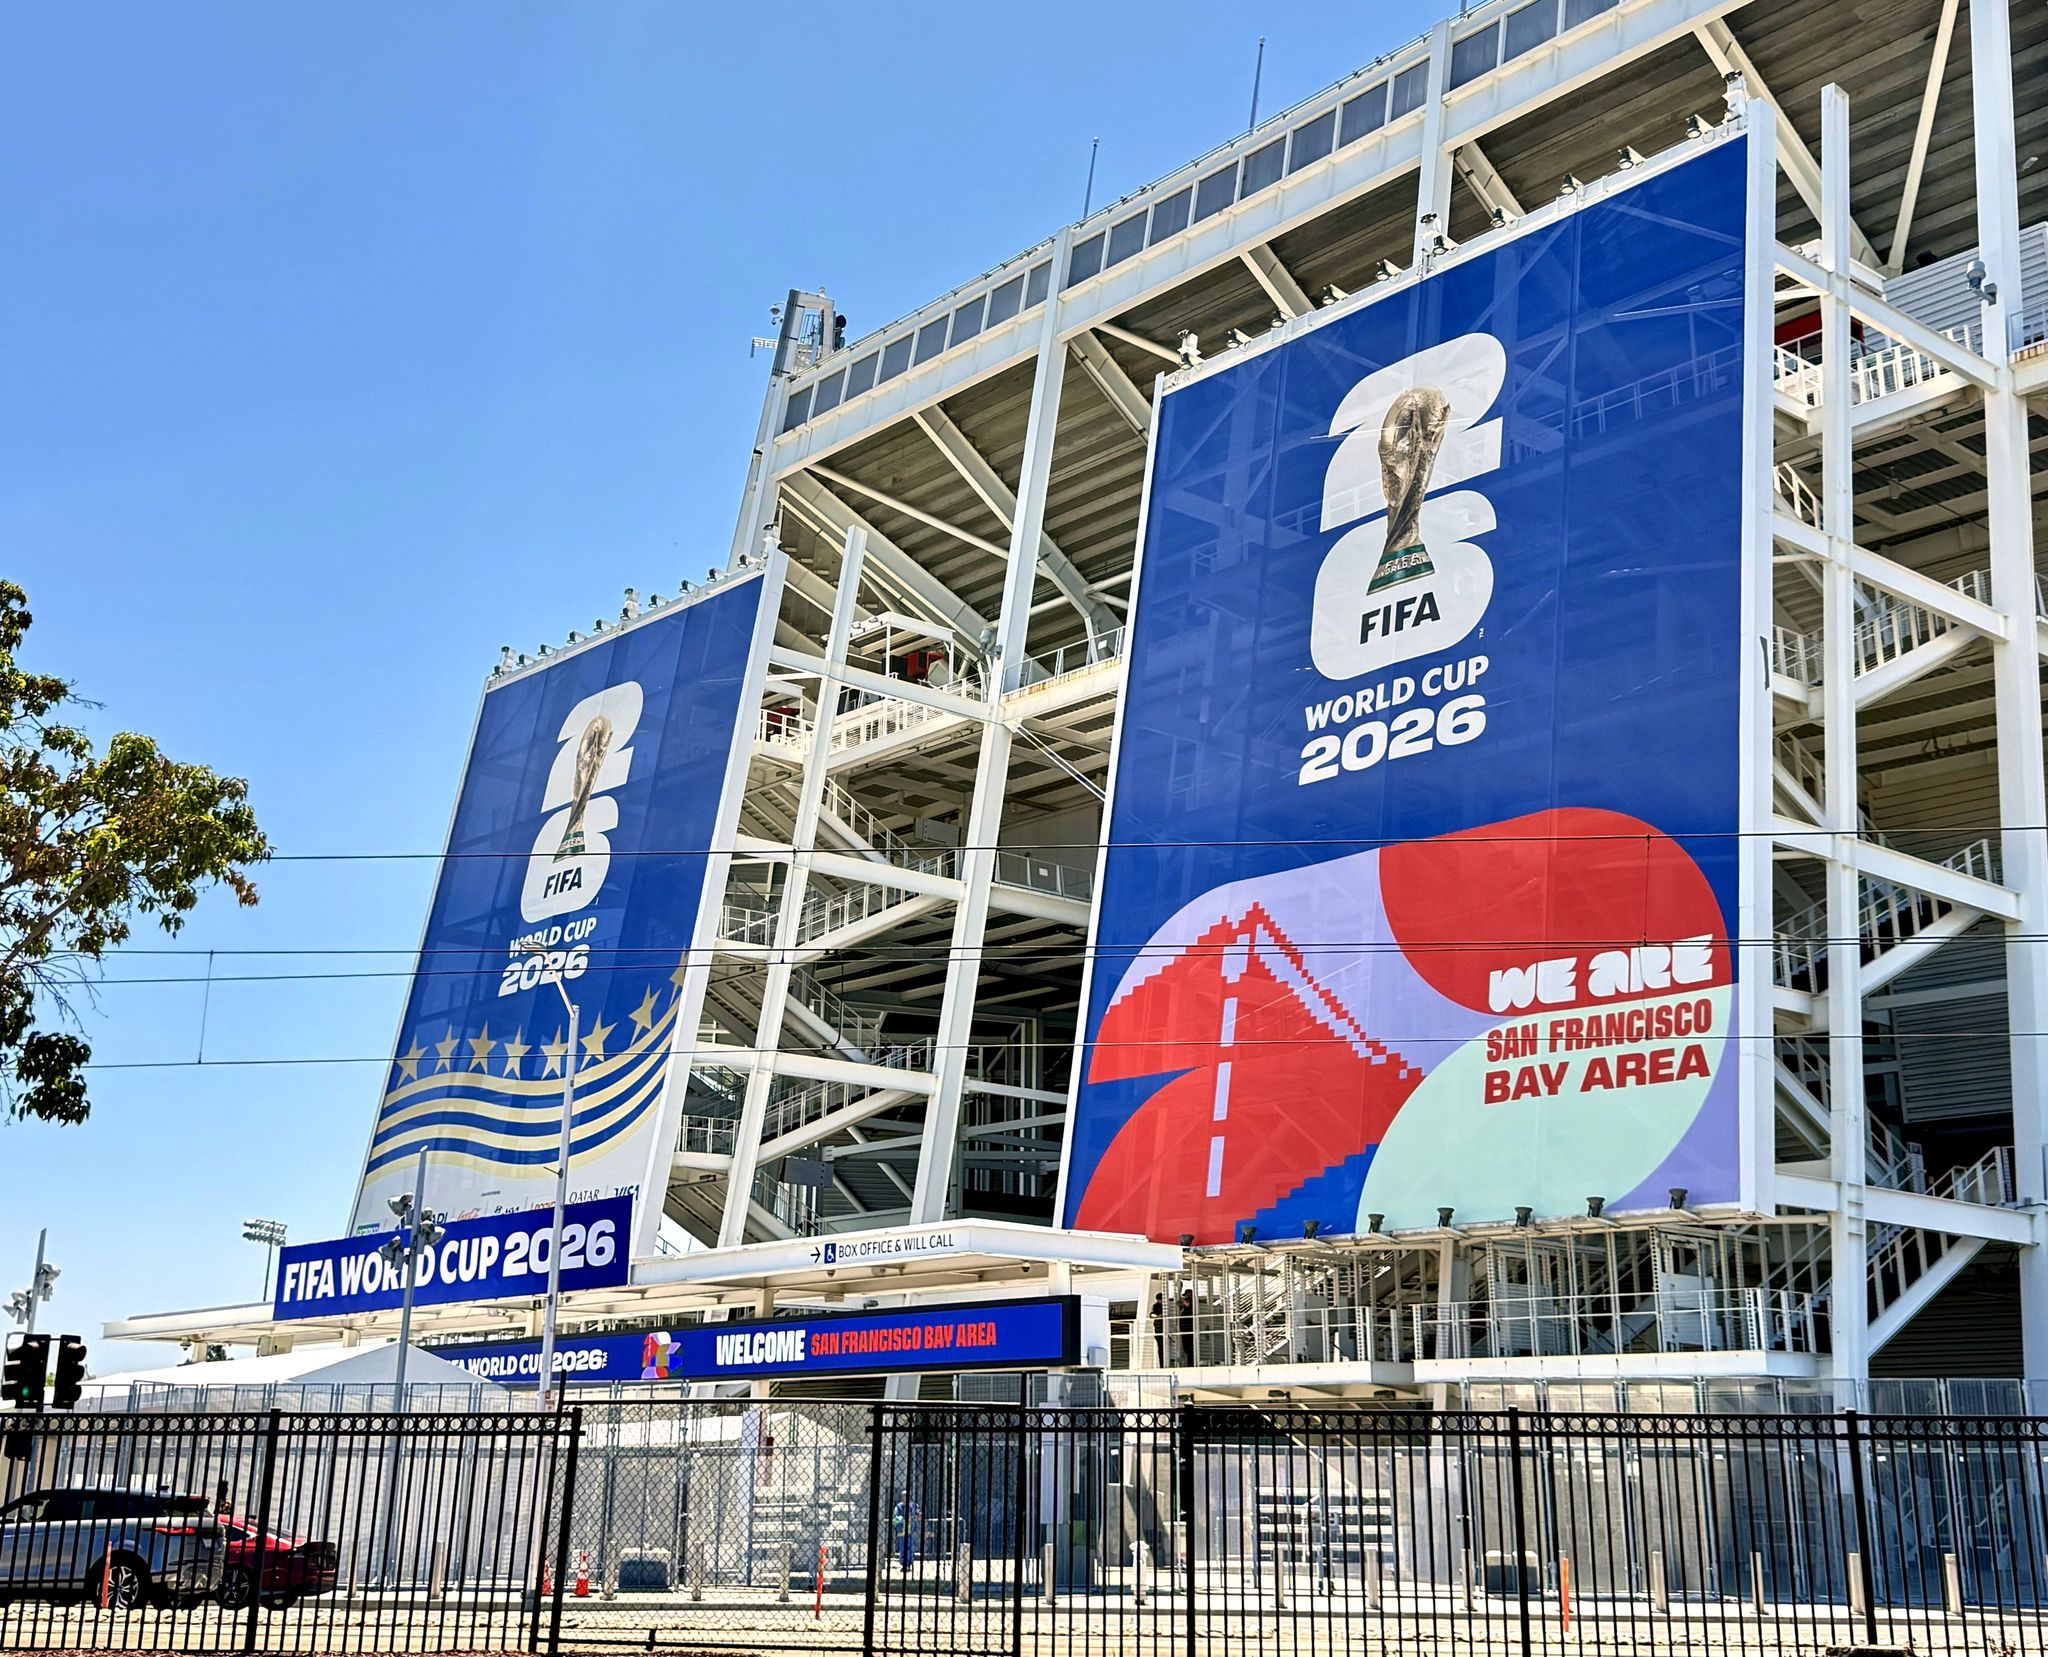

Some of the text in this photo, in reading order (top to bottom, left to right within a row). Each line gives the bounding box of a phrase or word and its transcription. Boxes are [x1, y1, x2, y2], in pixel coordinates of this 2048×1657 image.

[1360, 590, 1441, 645] FIFA
[1304, 655, 1489, 732] WORLD CUP
[1298, 694, 1487, 786] 2026
[543, 866, 582, 899] FIFA
[563, 917, 597, 943] CUP
[498, 944, 591, 998] 2026
[1488, 957, 1577, 1013] WE
[1487, 998, 1712, 1063] SAN FRANCISCO
[1484, 1043, 1711, 1105] BAY AREA
[282, 1258, 336, 1303] FIFA
[440, 1235, 499, 1285] CUP
[502, 1219, 616, 1278] 2026
[838, 1234, 954, 1259] BOX OFFICE & WILL CALL
[468, 1356, 518, 1377] WORLD
[551, 1349, 603, 1372] 2026
[716, 1322, 997, 1366] WELCOME SAN FRANCISCO BAY AREA
